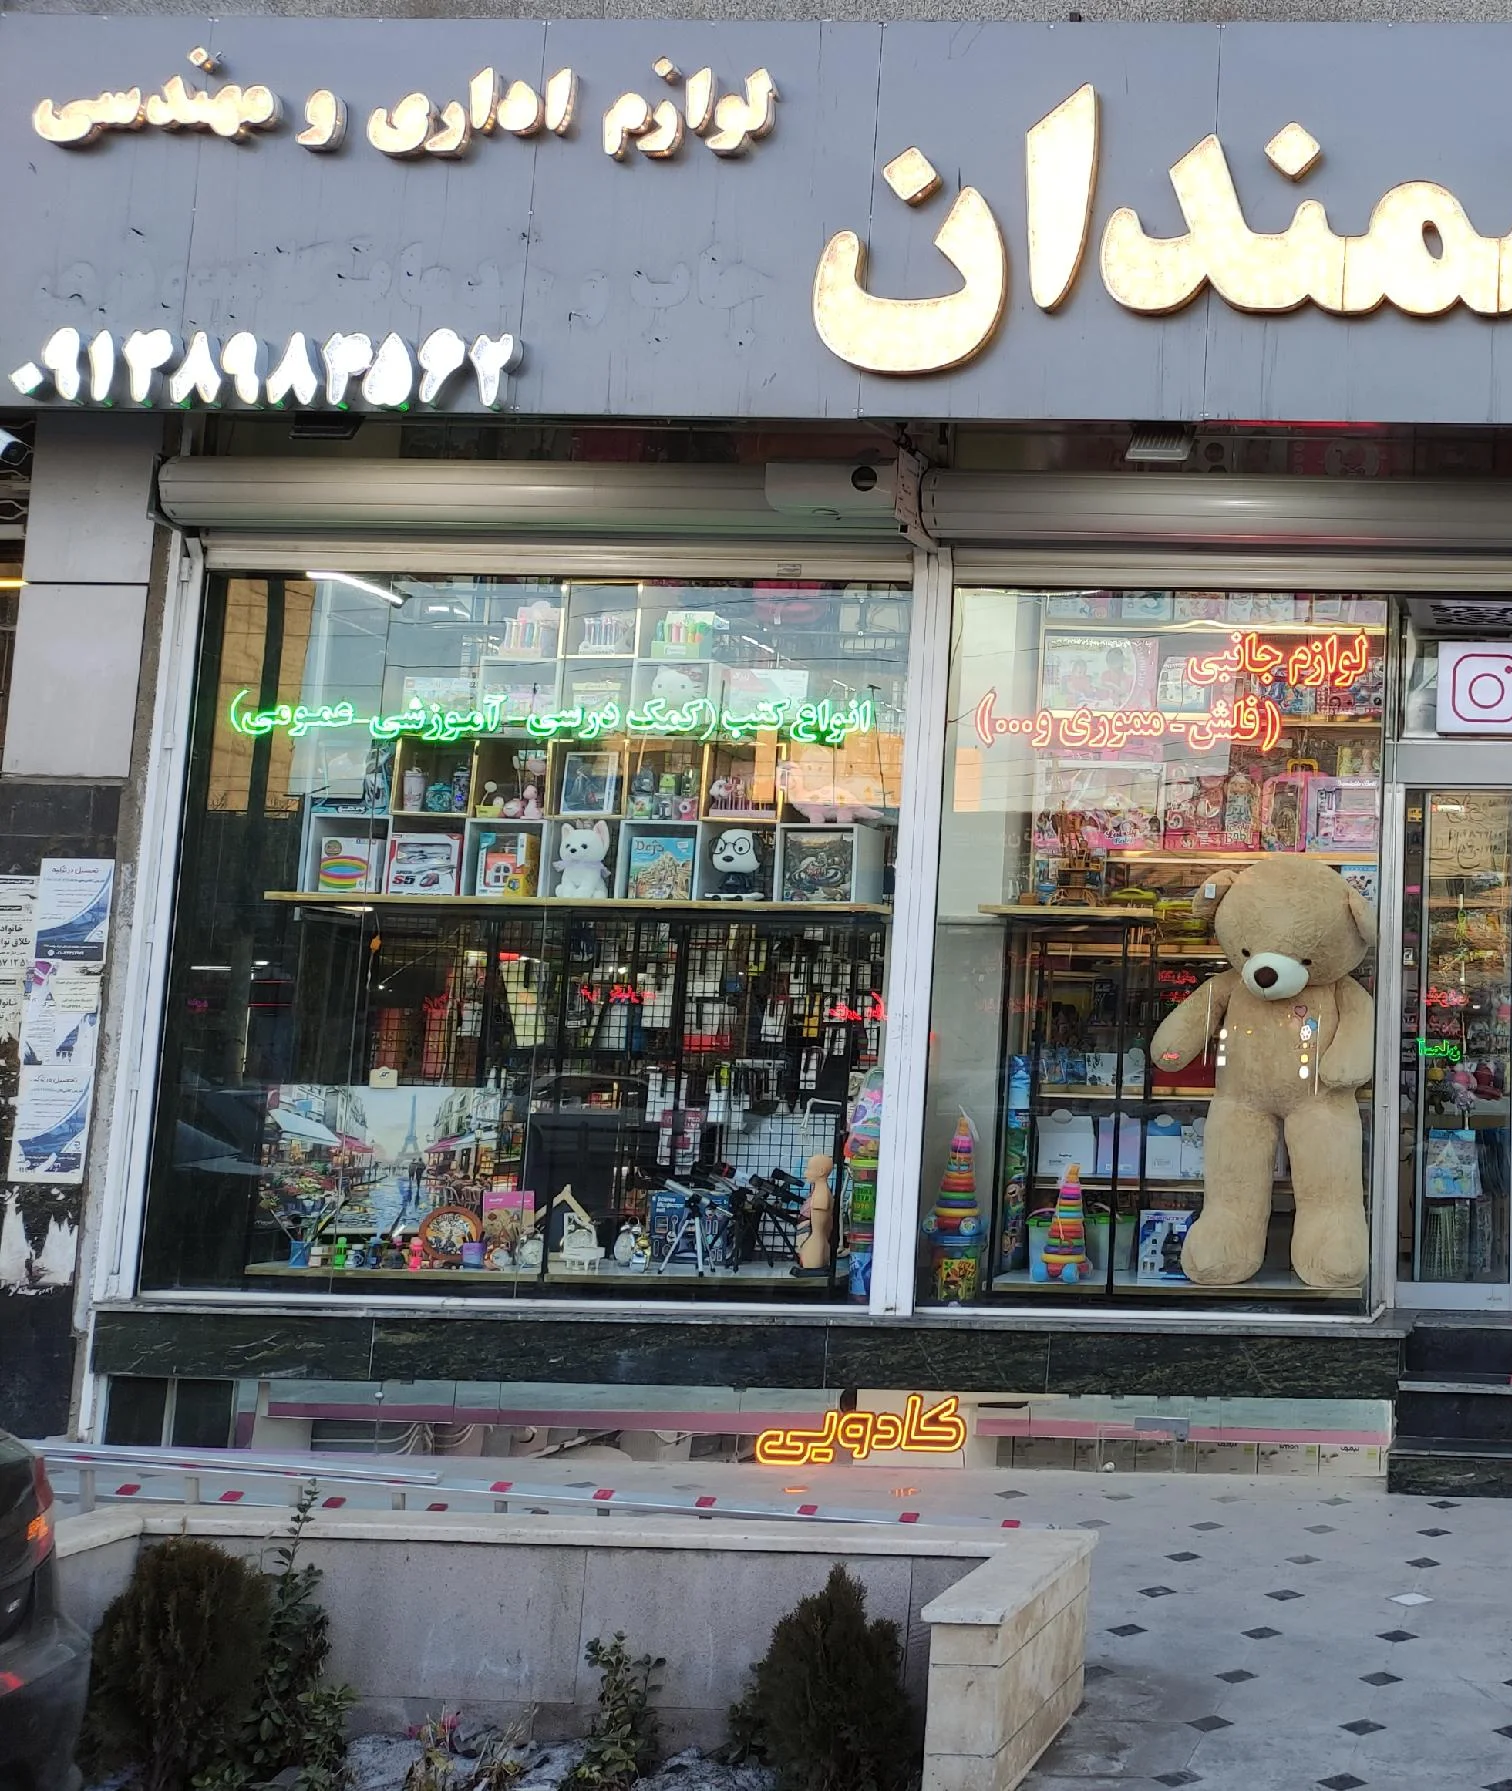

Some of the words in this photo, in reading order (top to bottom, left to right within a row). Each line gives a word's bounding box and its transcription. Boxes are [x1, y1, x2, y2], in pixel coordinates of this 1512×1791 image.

[32, 46, 285, 146] مهندسی
[296, 88, 348, 153] و
[367, 66, 580, 158] اداری
[603, 55, 778, 160] لوازم
[1186, 630, 1282, 686] جانبی
[1287, 631, 1369, 687] لوازم
[721, 697, 791, 742] کتب
[791, 698, 873, 744] انواع
[1059, 706, 1165, 748] مموری
